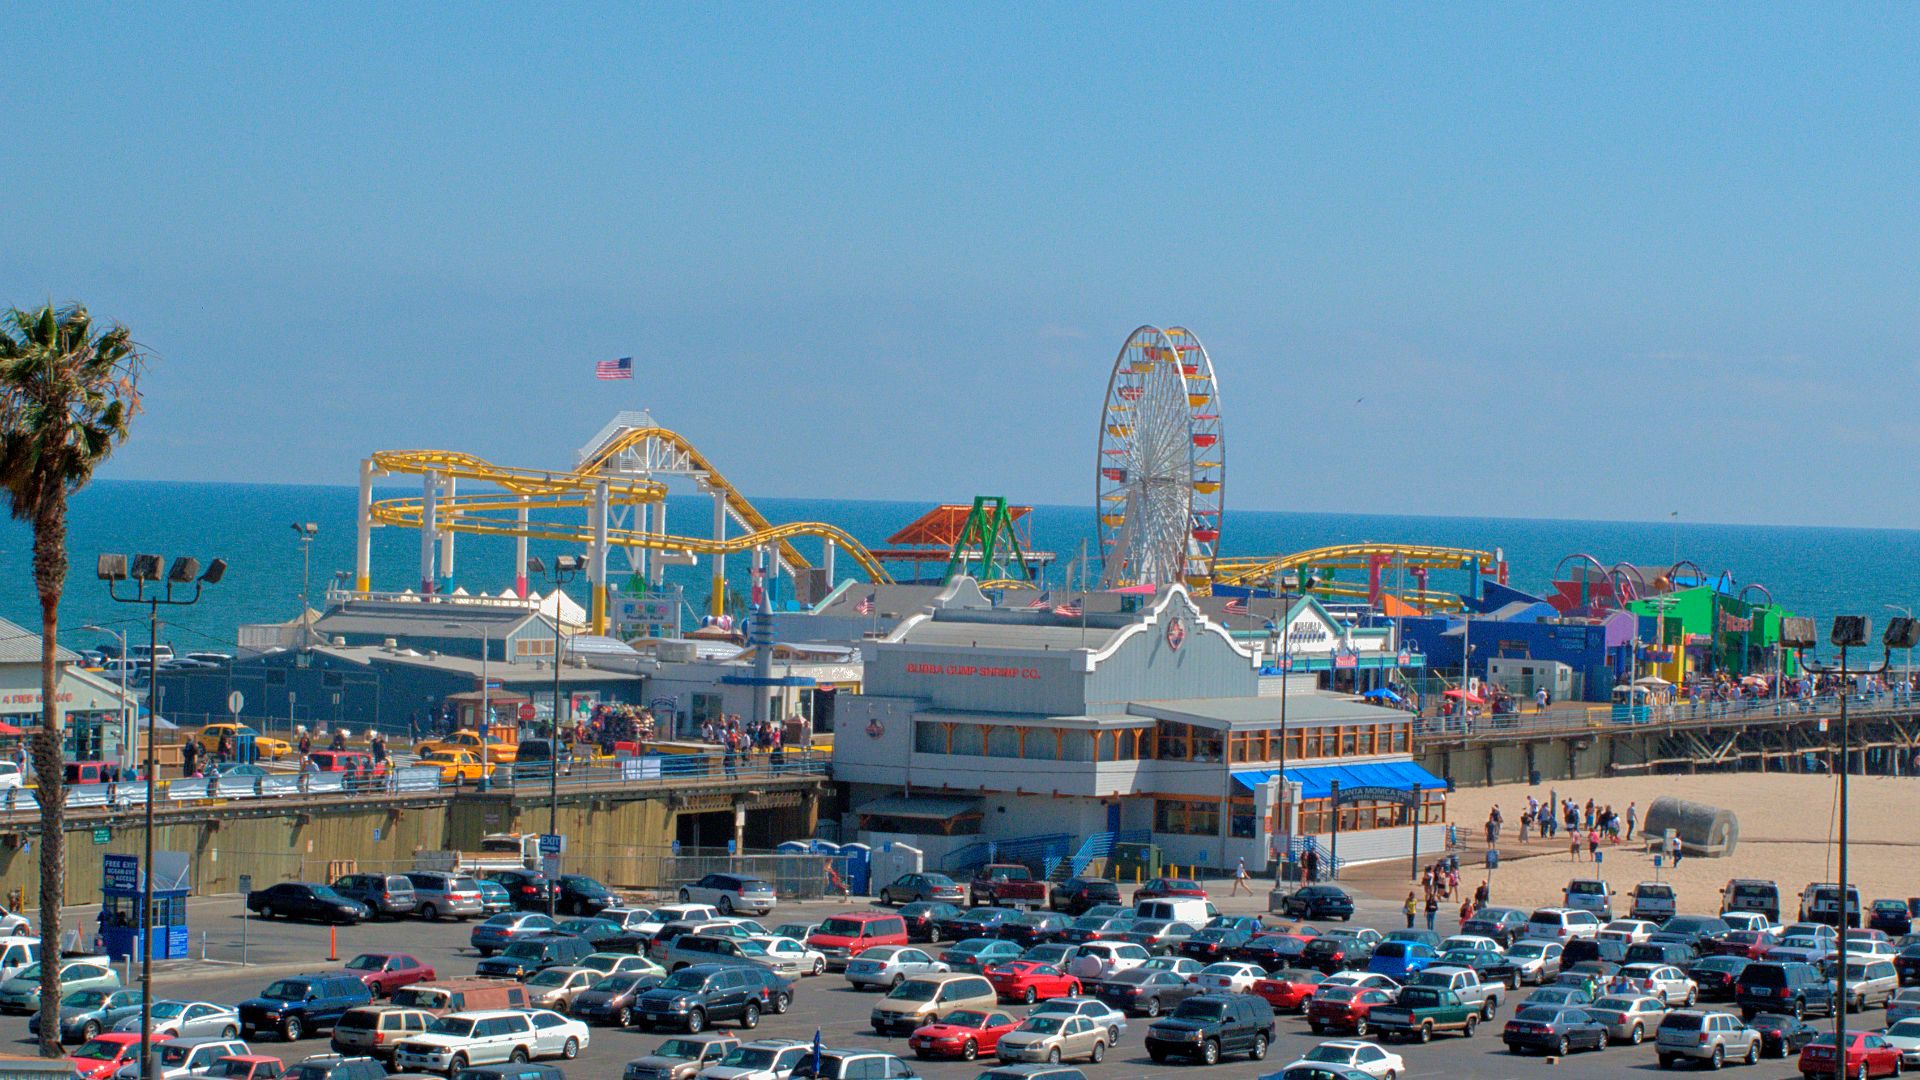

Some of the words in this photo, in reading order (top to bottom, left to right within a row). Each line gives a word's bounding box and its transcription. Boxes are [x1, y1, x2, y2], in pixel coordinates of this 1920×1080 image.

[906, 663, 943, 674] BUBBA
[979, 666, 1018, 678] SHRIMP
[1339, 788, 1363, 798] SANTA
[1364, 787, 1396, 796] MONICA
[1397, 790, 1413, 800] PIER
[541, 836, 560, 846] EXIT
[105, 860, 121, 868] FREE
[123, 861, 137, 869] EXIT
